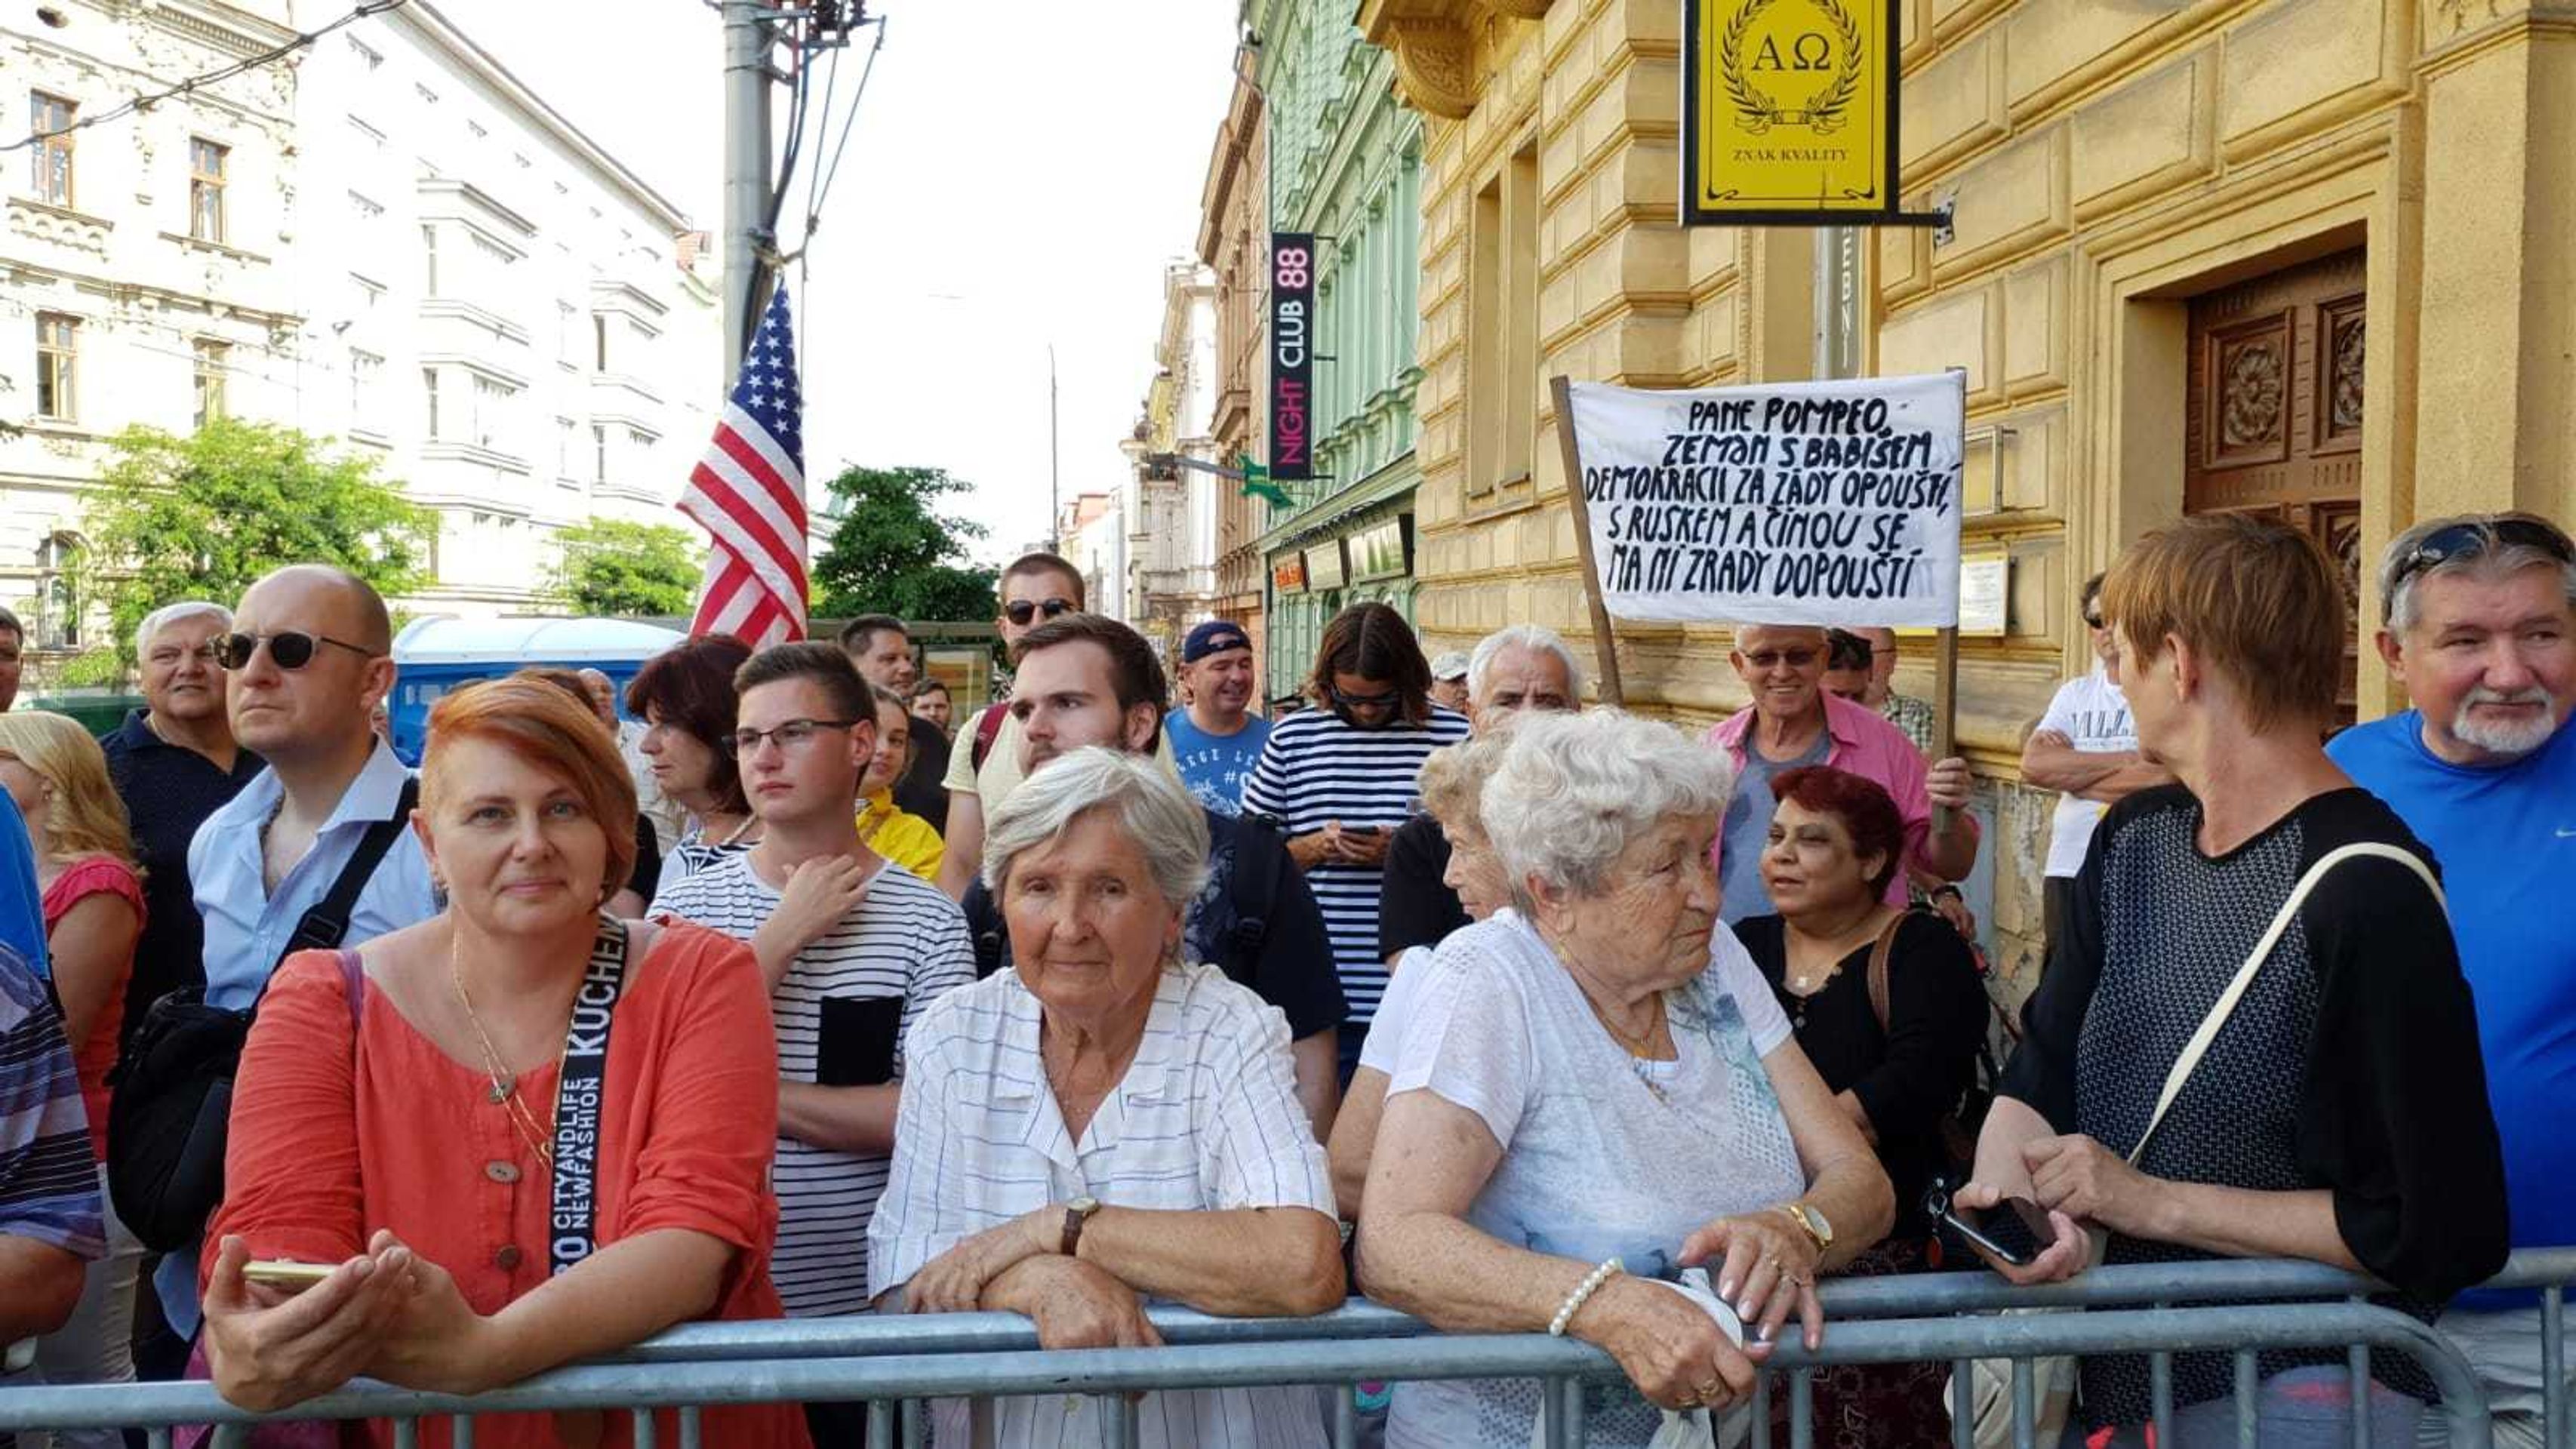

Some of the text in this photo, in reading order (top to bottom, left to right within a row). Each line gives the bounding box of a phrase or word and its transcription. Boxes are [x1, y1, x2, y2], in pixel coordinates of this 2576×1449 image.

[1733, 149, 1848, 162] ZNAK KVALITY
[1277, 247, 1308, 465] NIGHT CLUB 88
[1688, 399, 1756, 432] PANE
[1777, 437, 1799, 468] S
[1803, 426, 1932, 471] BABIŠEM
[1586, 465, 1727, 503] DEMOKRACII
[1733, 466, 1765, 505] ZA
[1771, 468, 1839, 506] ZÁDY
[1607, 504, 1909, 552] S RUSKEM A ČÍNOU SE
[1607, 543, 1642, 593] NA
[1682, 549, 1772, 594] ZRADY
[1773, 548, 1923, 599] DOPOUŠTÍ
[553, 1078, 581, 1229] CITYANDLIFE
[571, 1077, 600, 1228] NEWFASHION
